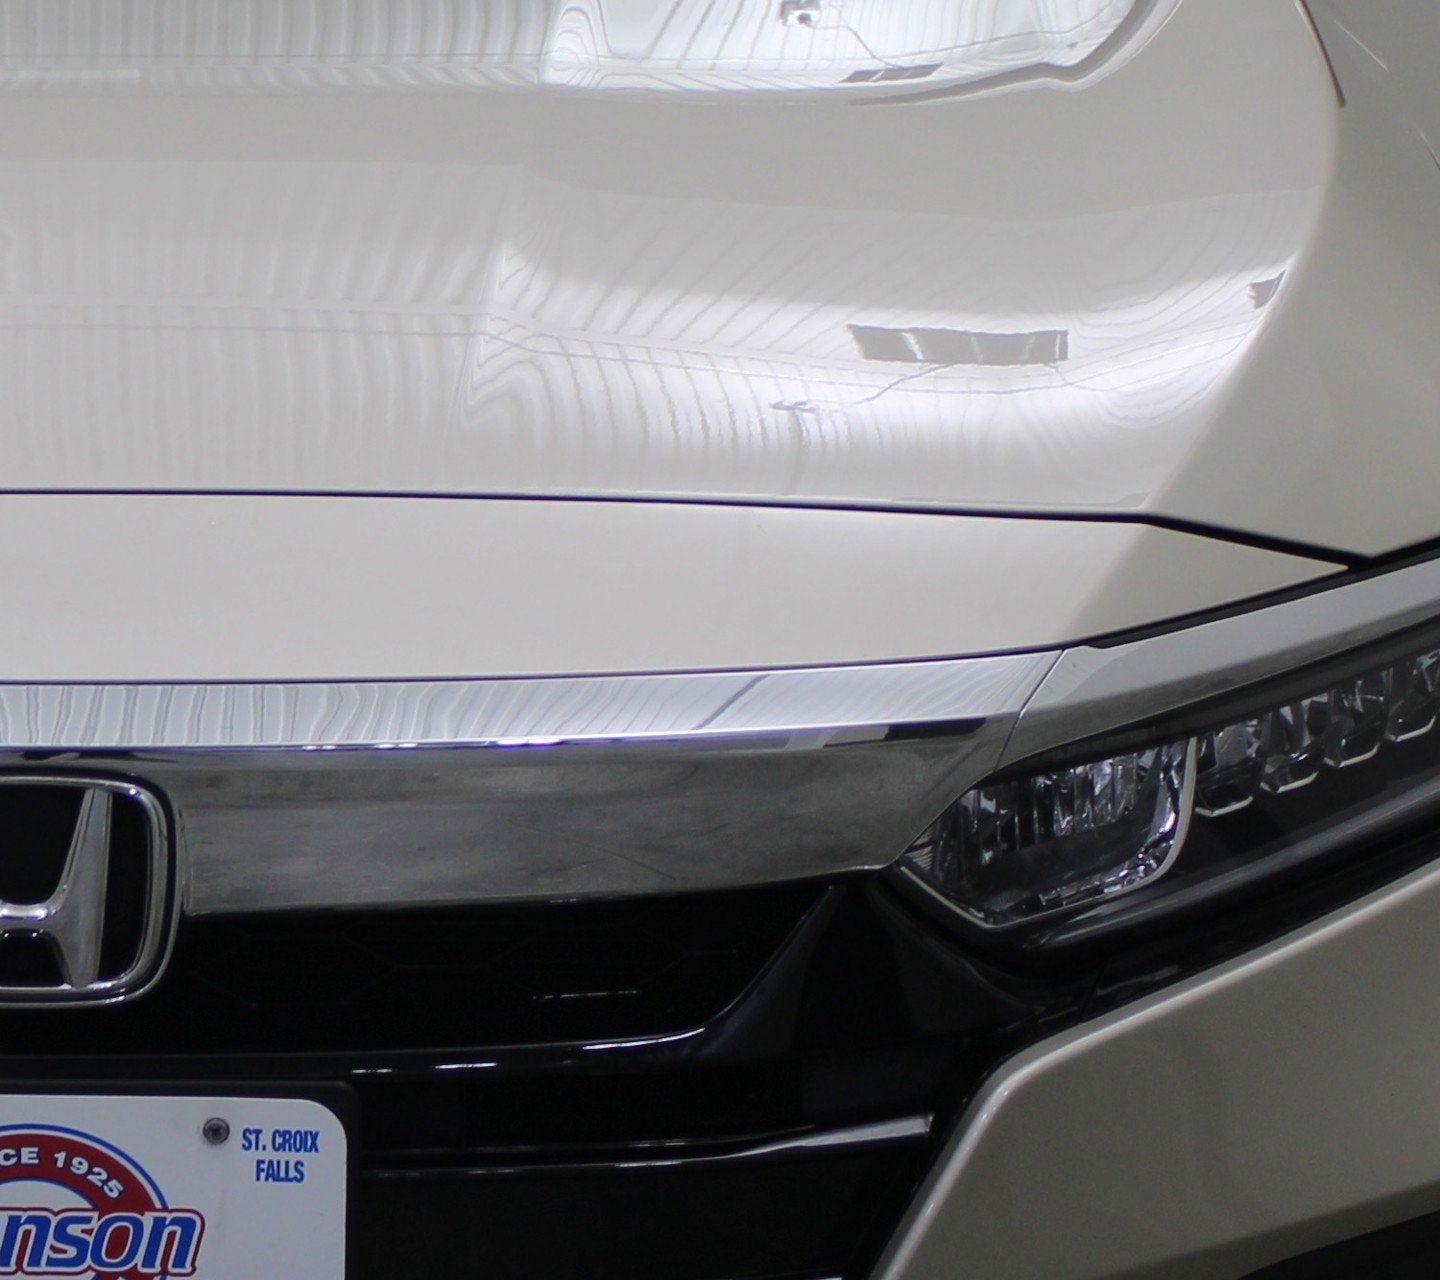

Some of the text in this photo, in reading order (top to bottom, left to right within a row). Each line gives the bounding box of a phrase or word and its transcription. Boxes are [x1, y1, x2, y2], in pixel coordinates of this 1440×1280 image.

[242, 1128, 320, 1153] ST. CROIX
[53, 1150, 125, 1199] 1925
[255, 1158, 306, 1184] FALLS
